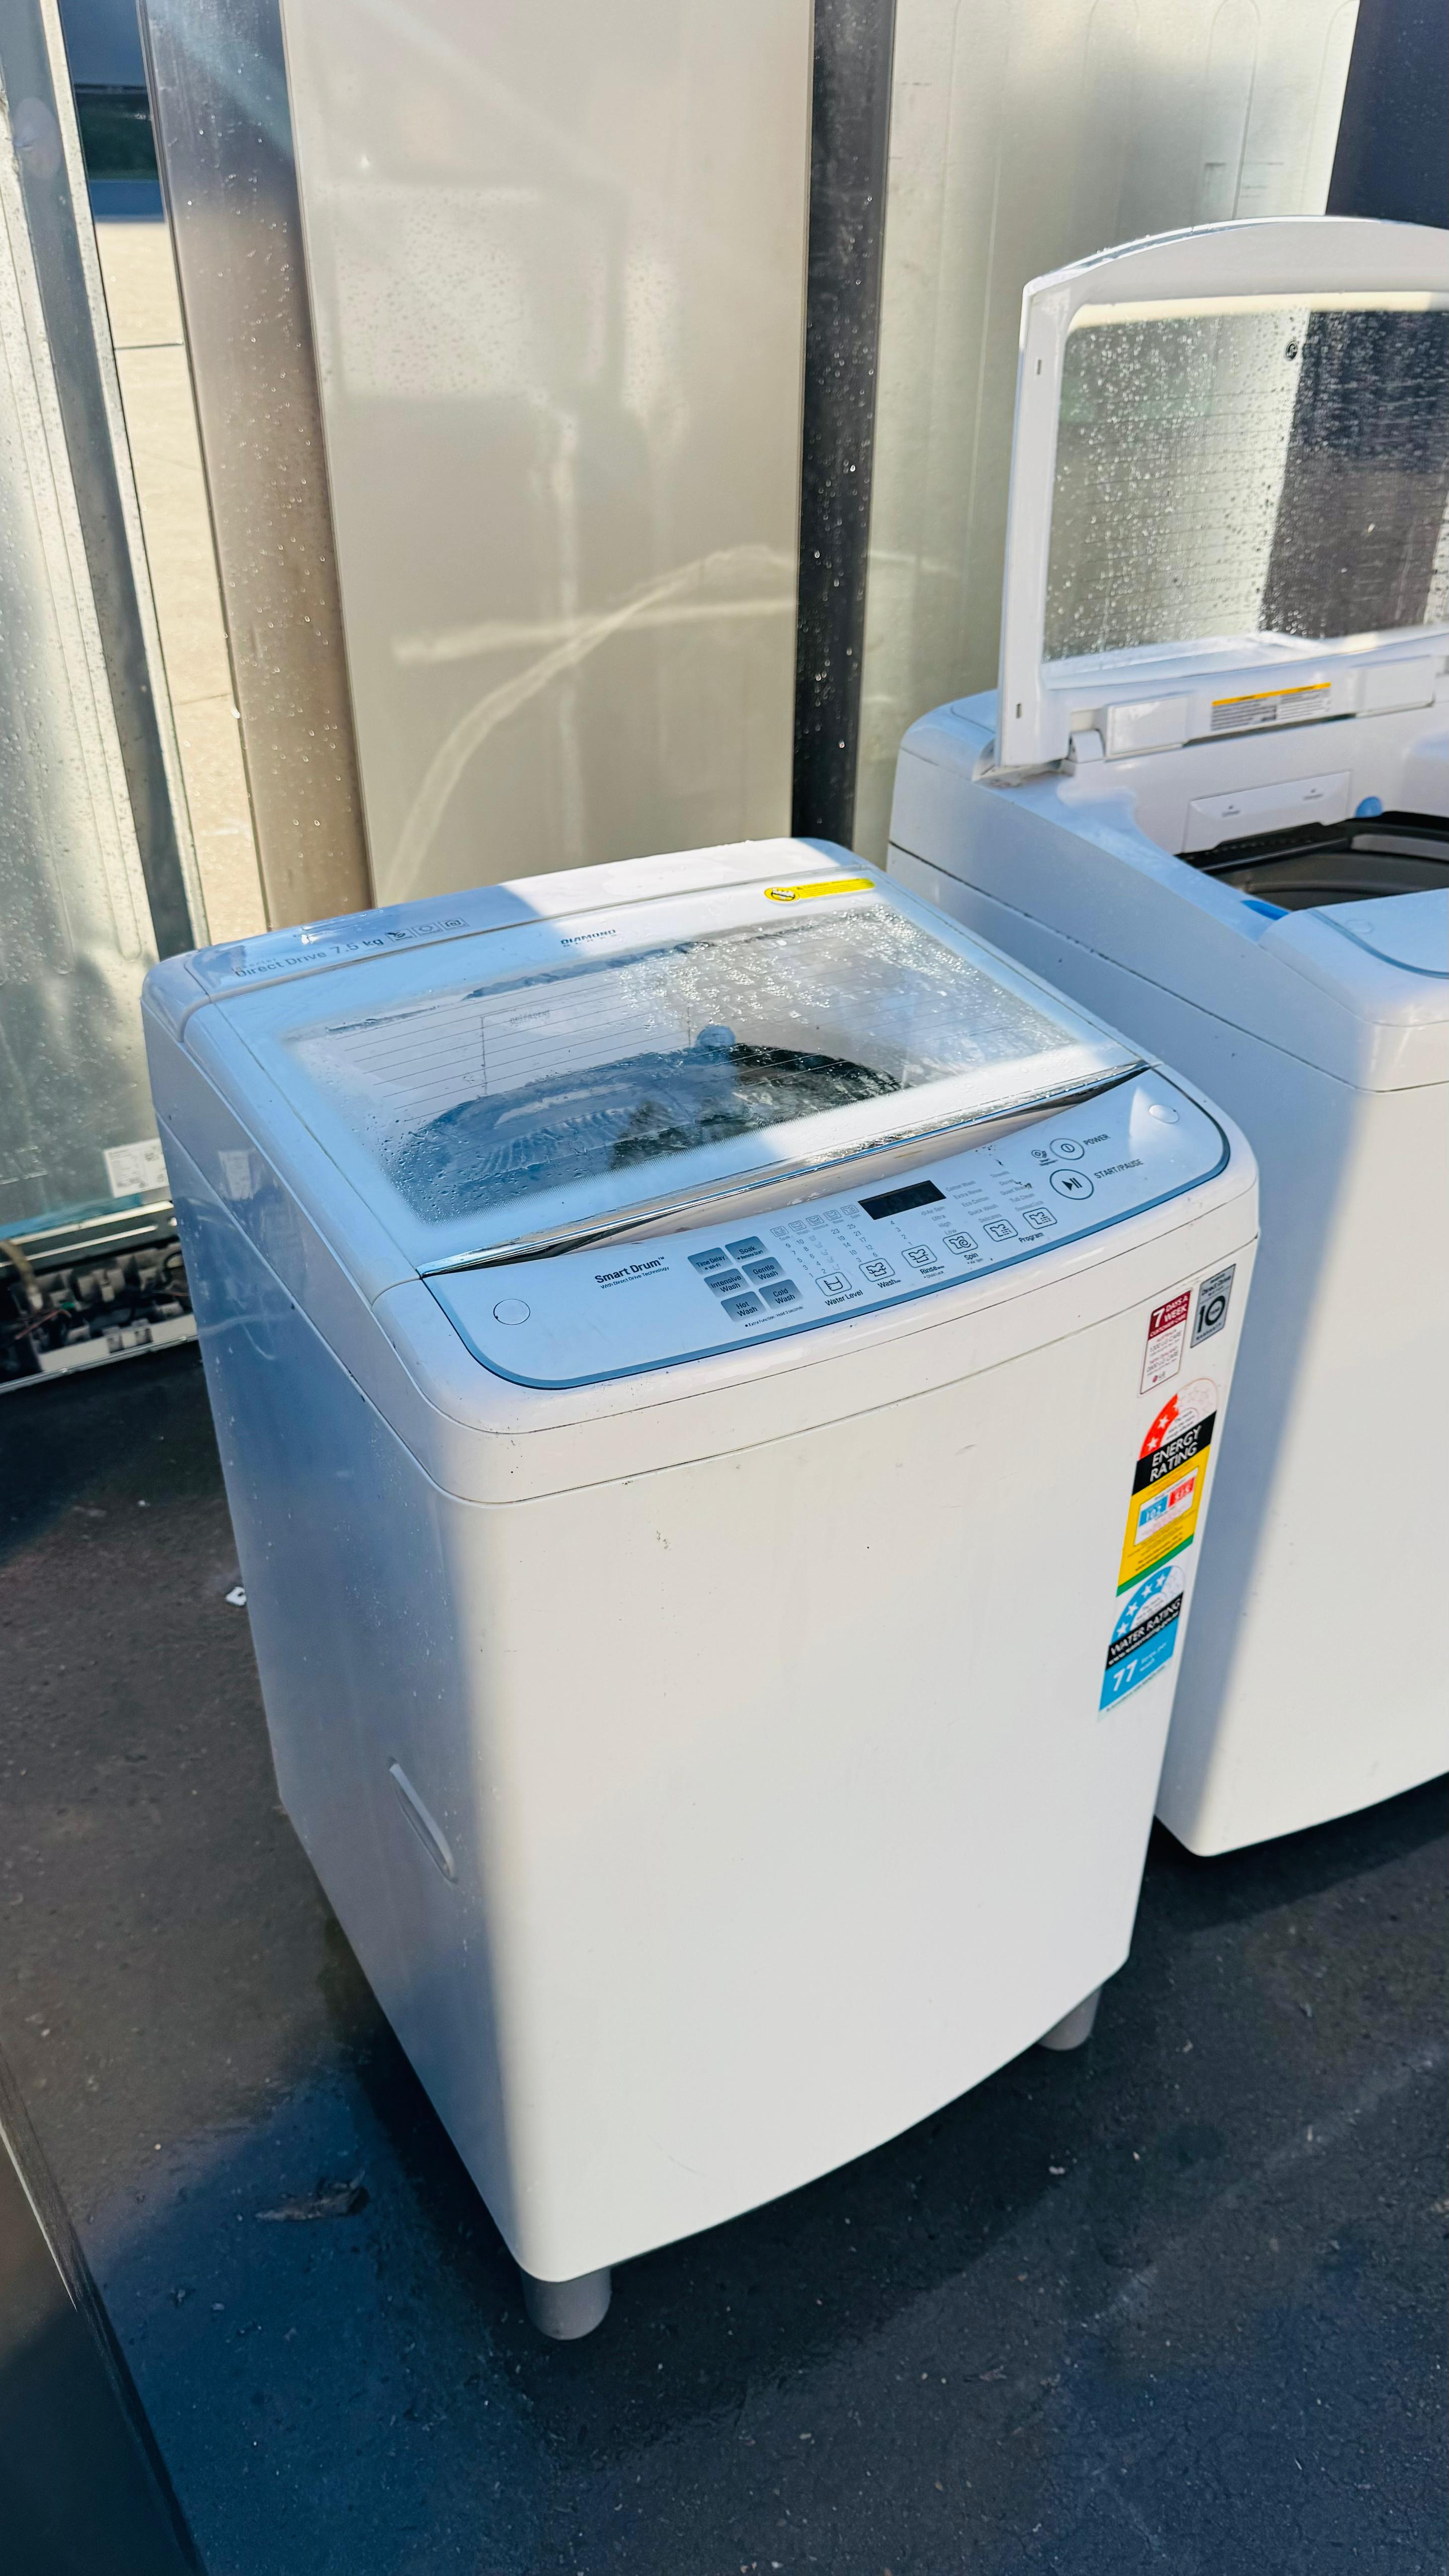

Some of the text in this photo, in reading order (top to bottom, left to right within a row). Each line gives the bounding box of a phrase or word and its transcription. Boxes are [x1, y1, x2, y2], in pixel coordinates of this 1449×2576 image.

[561, 929, 616, 944] DIAMOND
[235, 961, 284, 977] Direct
[285, 951, 327, 965] Drive
[330, 943, 359, 954] 7.5
[1083, 1134, 1111, 1146] POWER
[1094, 1159, 1145, 1179] START/PAUSE
[1018, 1232, 1044, 1243] Program
[739, 1246, 757, 1254] Soak
[964, 1252, 979, 1260] Spin
[696, 1255, 726, 1267] Time Delay
[595, 1268, 630, 1283] Smart
[613, 1278, 629, 1286] Direct
[642, 1266, 669, 1277] Technology
[753, 1264, 775, 1275] Gentle
[758, 1270, 779, 1280] Wash
[710, 1275, 742, 1289] Intensive
[720, 1283, 741, 1293] Wash
[773, 1287, 788, 1297] Cold
[775, 1294, 796, 1304] Wash
[825, 1290, 864, 1307] Water Level
[736, 1301, 750, 1310] Hot
[737, 1307, 758, 1317] Wash
[1164, 1303, 1187, 1322] WEEK
[1153, 1308, 1165, 1328] 7
[1197, 1296, 1226, 1334] 10
[1152, 1425, 1202, 1467] ENERGY
[1150, 1442, 1198, 1482] RATING
[1110, 1627, 1145, 1656] WATER
[1147, 1597, 1181, 1632] RATING
[1113, 1659, 1139, 1692] 77
